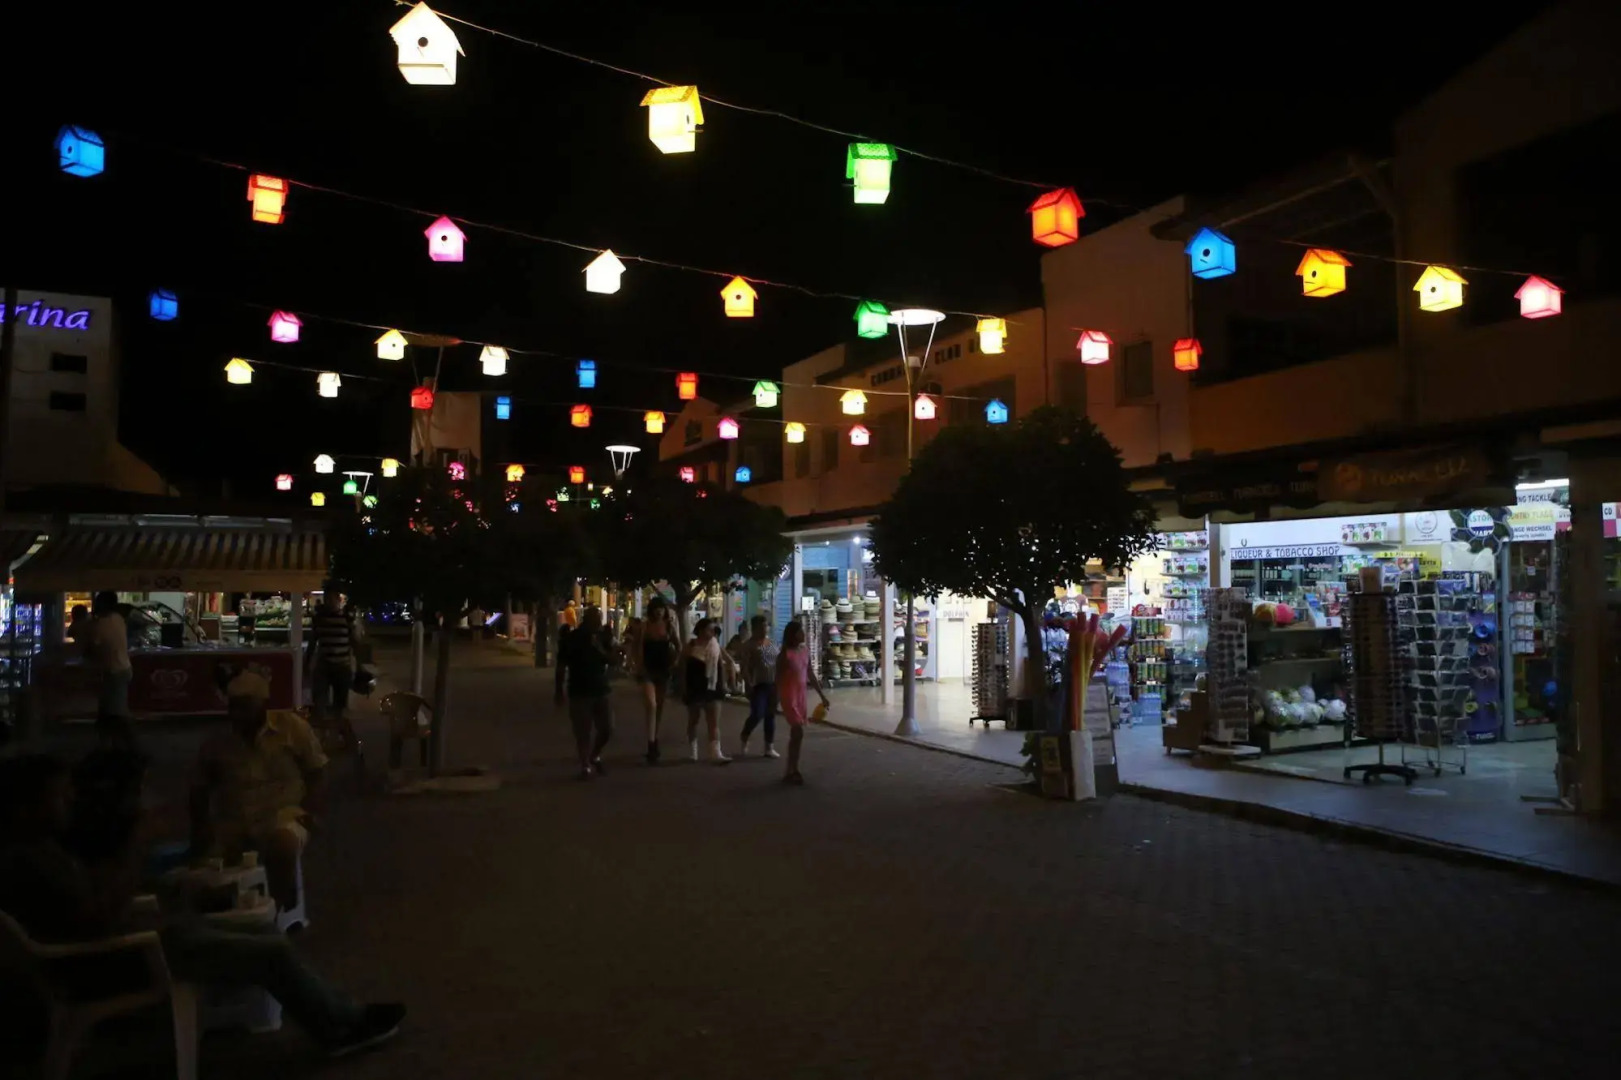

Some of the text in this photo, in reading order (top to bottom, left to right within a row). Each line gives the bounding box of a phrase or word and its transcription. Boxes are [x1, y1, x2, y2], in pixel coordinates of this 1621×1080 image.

[1528, 493, 1552, 502] TACKLE
[1230, 545, 1340, 559] LIQUEUR & TOBACCO SHOP
